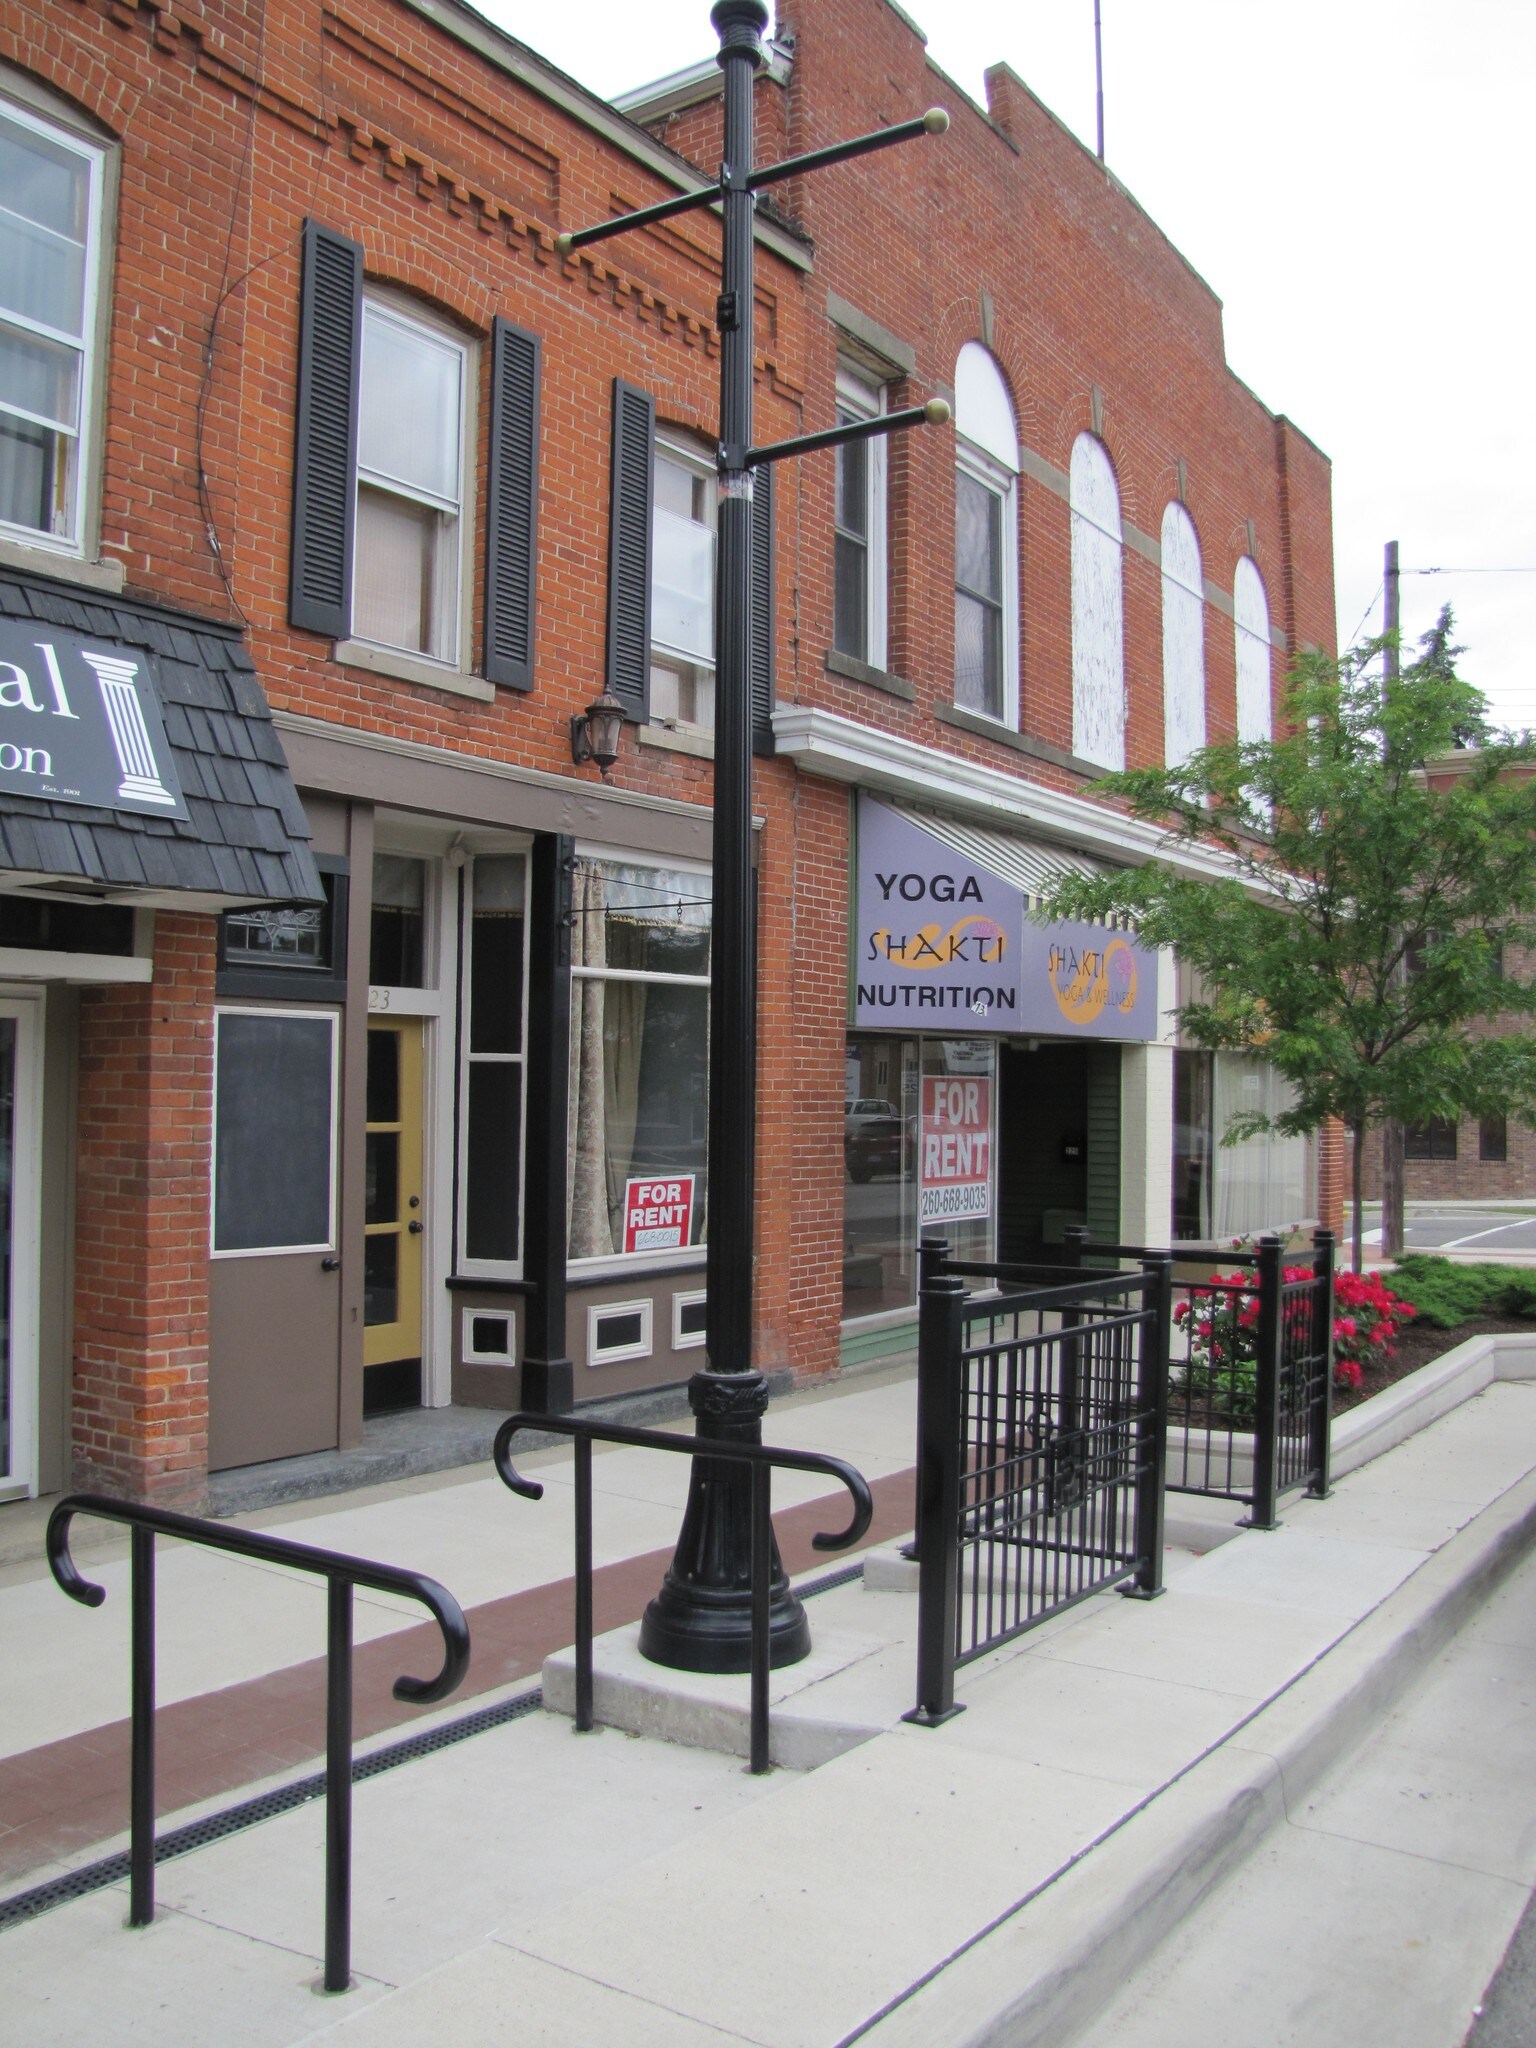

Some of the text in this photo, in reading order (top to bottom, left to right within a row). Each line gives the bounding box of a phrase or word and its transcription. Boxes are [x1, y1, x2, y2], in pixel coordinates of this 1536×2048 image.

[874, 873, 984, 903] YOGA
[867, 931, 1003, 963] SHAKTI
[1048, 943, 1105, 979] SHAKTI
[857, 984, 1016, 1010] NUTRITION
[1058, 983, 1084, 1003] YOGA
[1095, 989, 1135, 1008] WELLNESS
[933, 1080, 980, 1127] FOR
[924, 1131, 988, 1179] RENT
[637, 1183, 682, 1206] FOR
[922, 1185, 987, 1216] 260-668-9035
[629, 1204, 688, 1228] RENT
